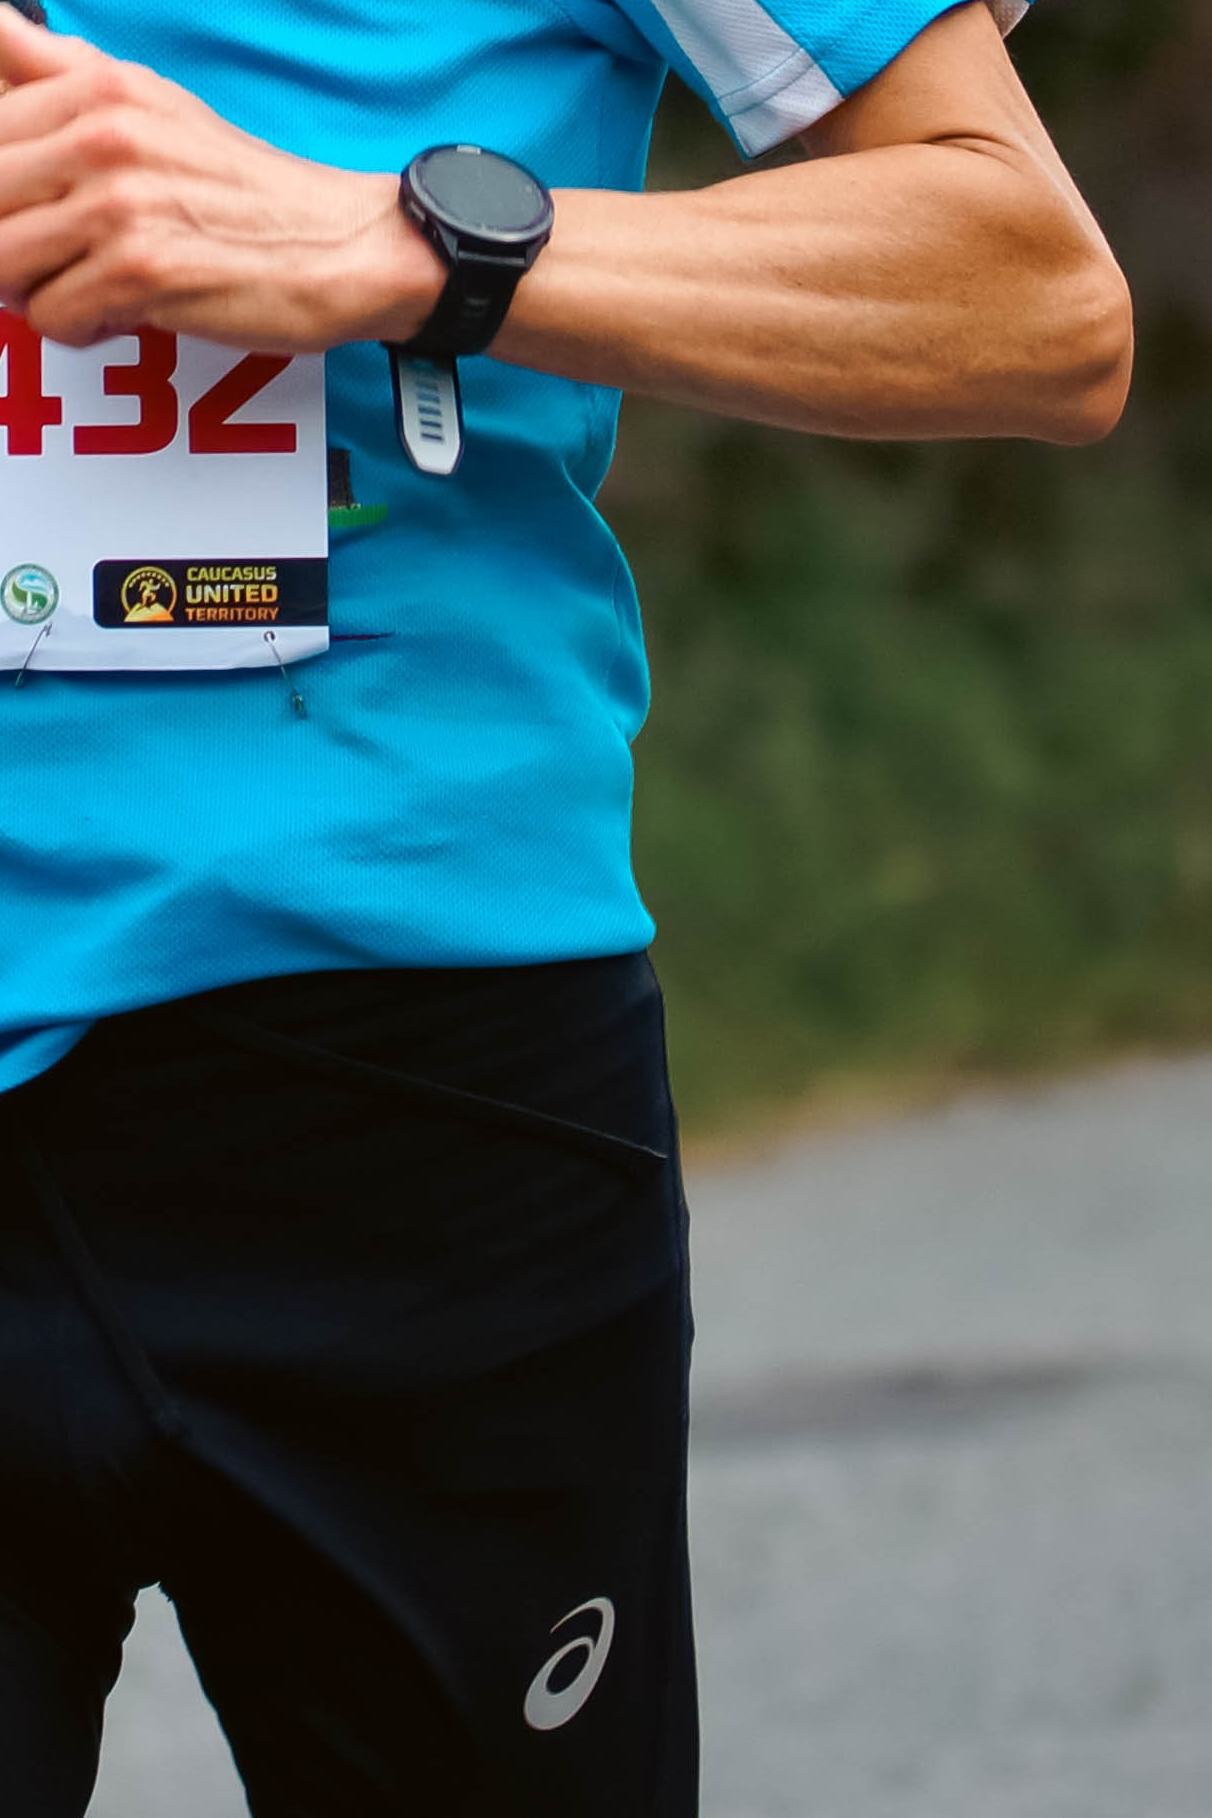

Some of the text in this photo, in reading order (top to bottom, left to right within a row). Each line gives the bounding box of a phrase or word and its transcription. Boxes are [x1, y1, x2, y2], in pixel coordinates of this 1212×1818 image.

[187, 566, 277, 582] CAUCASUS
[185, 584, 279, 604] UNITED
[185, 606, 280, 622] TERRITORY
